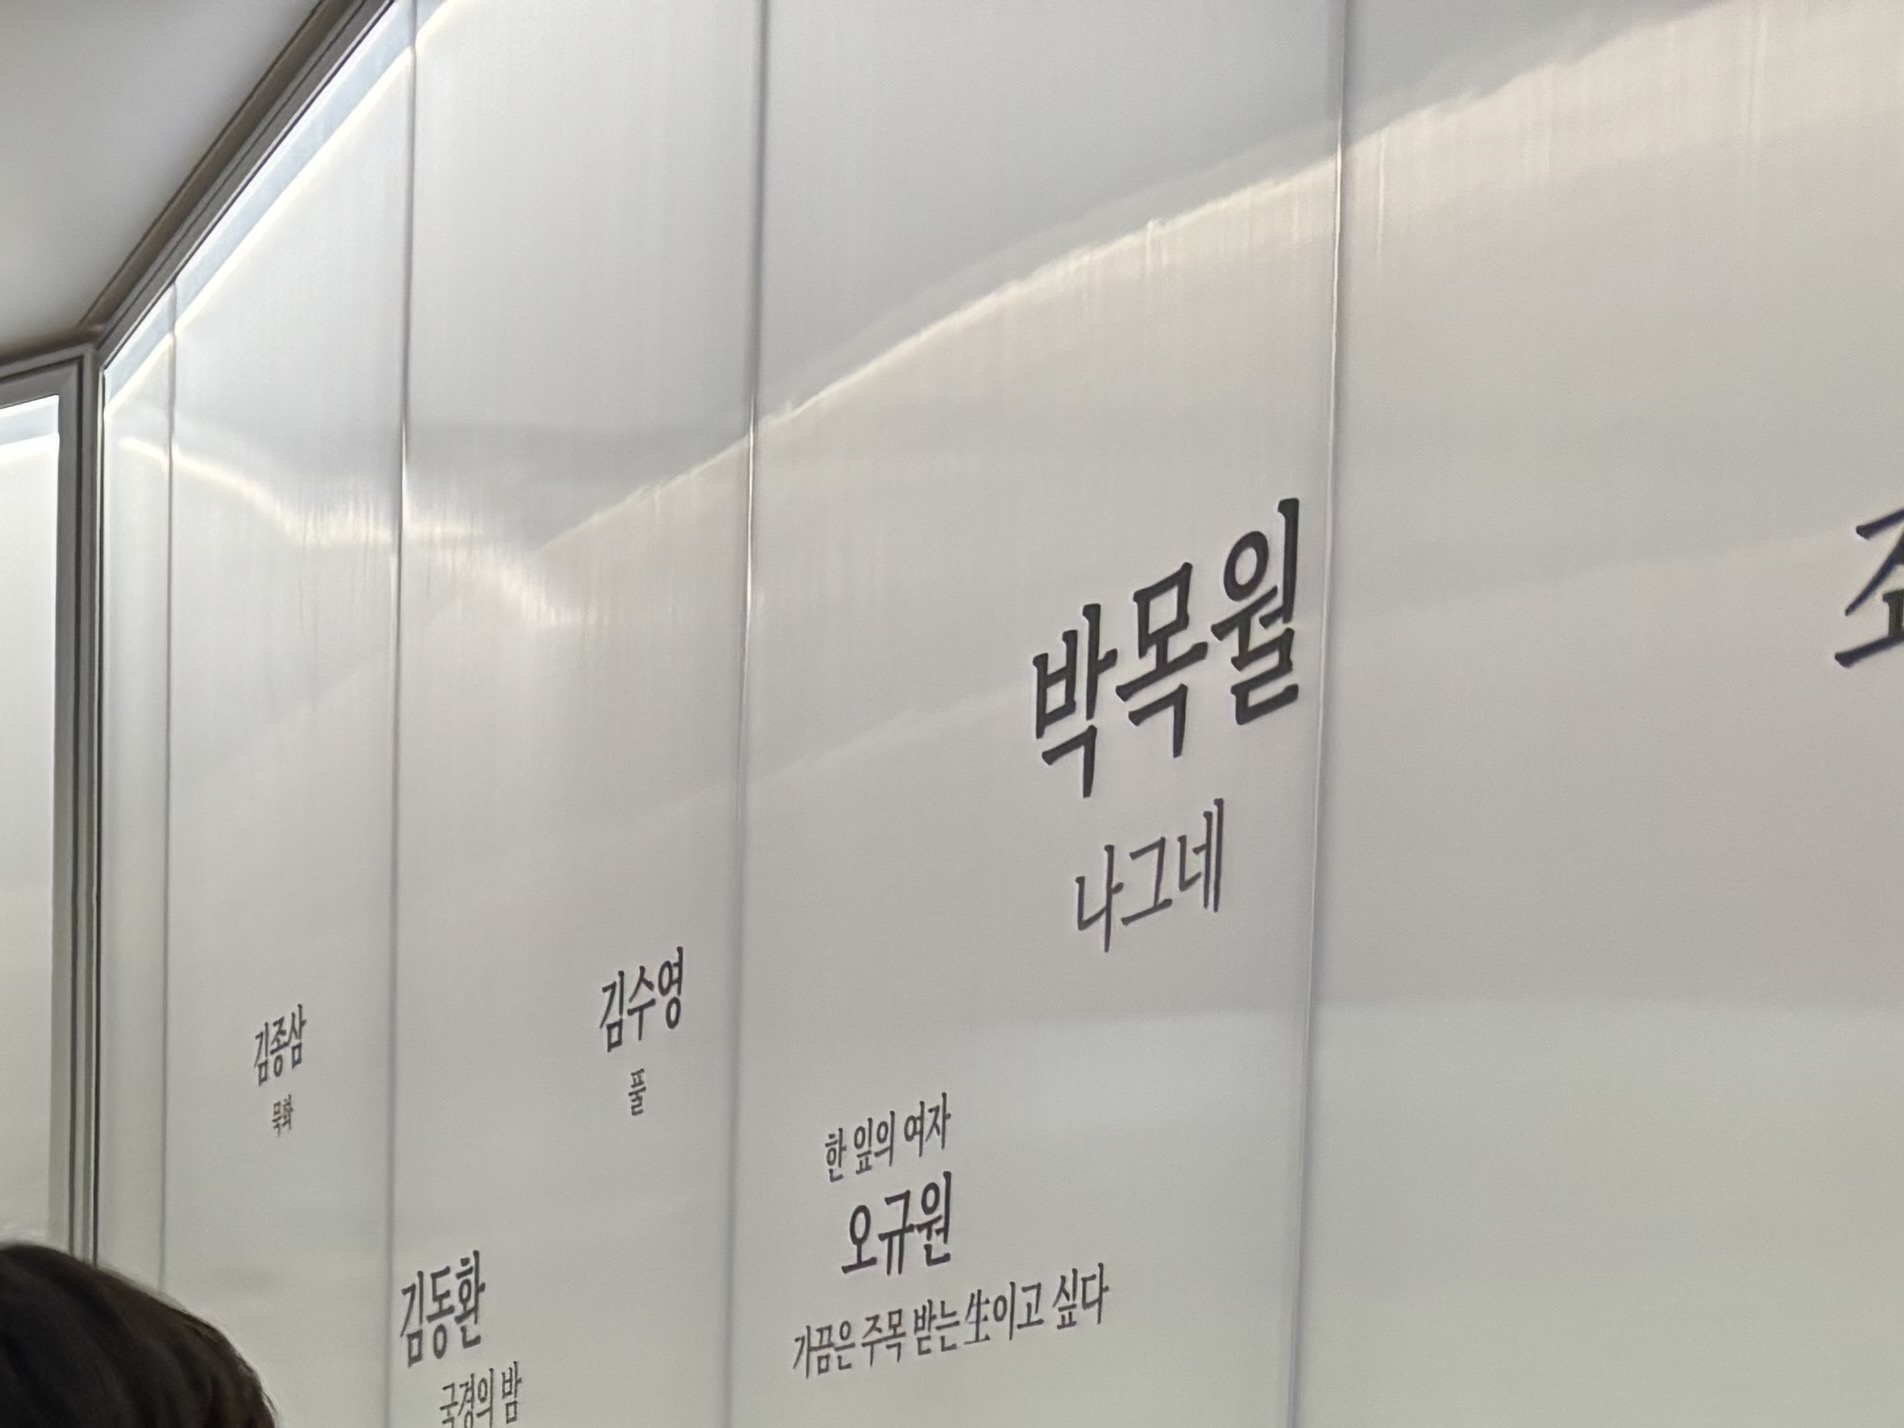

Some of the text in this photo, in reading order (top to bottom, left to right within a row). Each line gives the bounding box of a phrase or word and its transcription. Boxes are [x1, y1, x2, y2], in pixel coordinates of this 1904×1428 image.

[1032, 497, 1300, 798] 박목월
[1074, 796, 1225, 953] 나그네
[254, 1003, 307, 1087] 김종삼
[599, 945, 685, 1053] 김수영
[627, 1067, 647, 1116] 풀
[824, 1091, 952, 1183] 한 잎의 여자
[841, 1170, 952, 1276] 오규원
[400, 1250, 486, 1368] 김동환
[792, 1319, 856, 1380] 가끔은
[861, 1308, 907, 1367] 주목
[1052, 1262, 1110, 1330] 싶다
[500, 1360, 524, 1426] 밤
